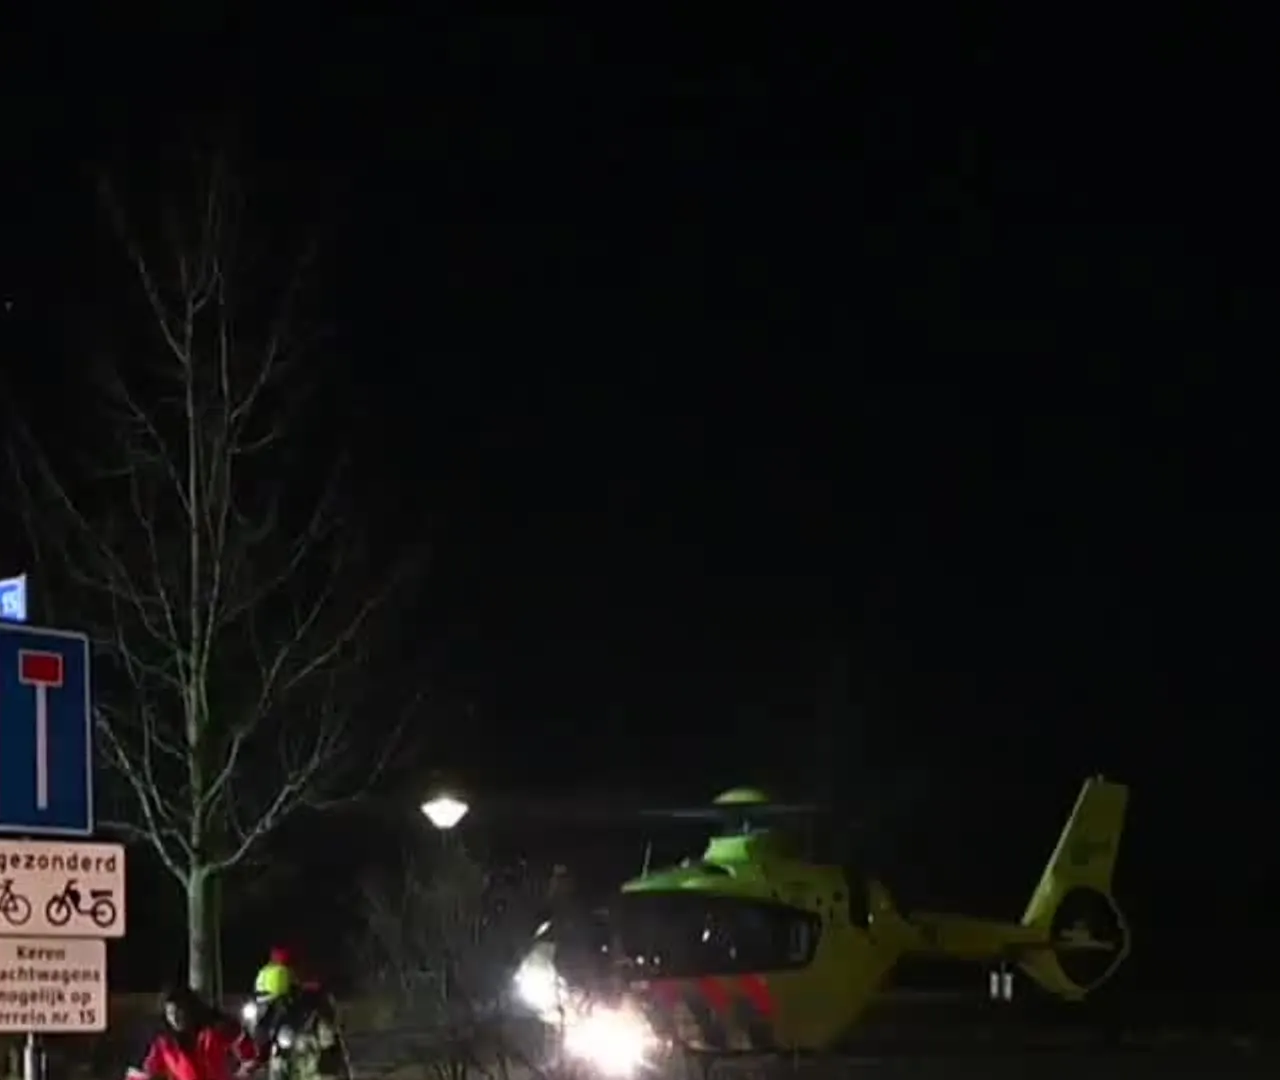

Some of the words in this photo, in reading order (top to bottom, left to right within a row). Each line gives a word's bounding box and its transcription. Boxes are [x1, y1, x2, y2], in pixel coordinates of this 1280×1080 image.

[16, 945, 66, 961] Keren
[70, 991, 92, 1007] op
[80, 1009, 96, 1025] 15
